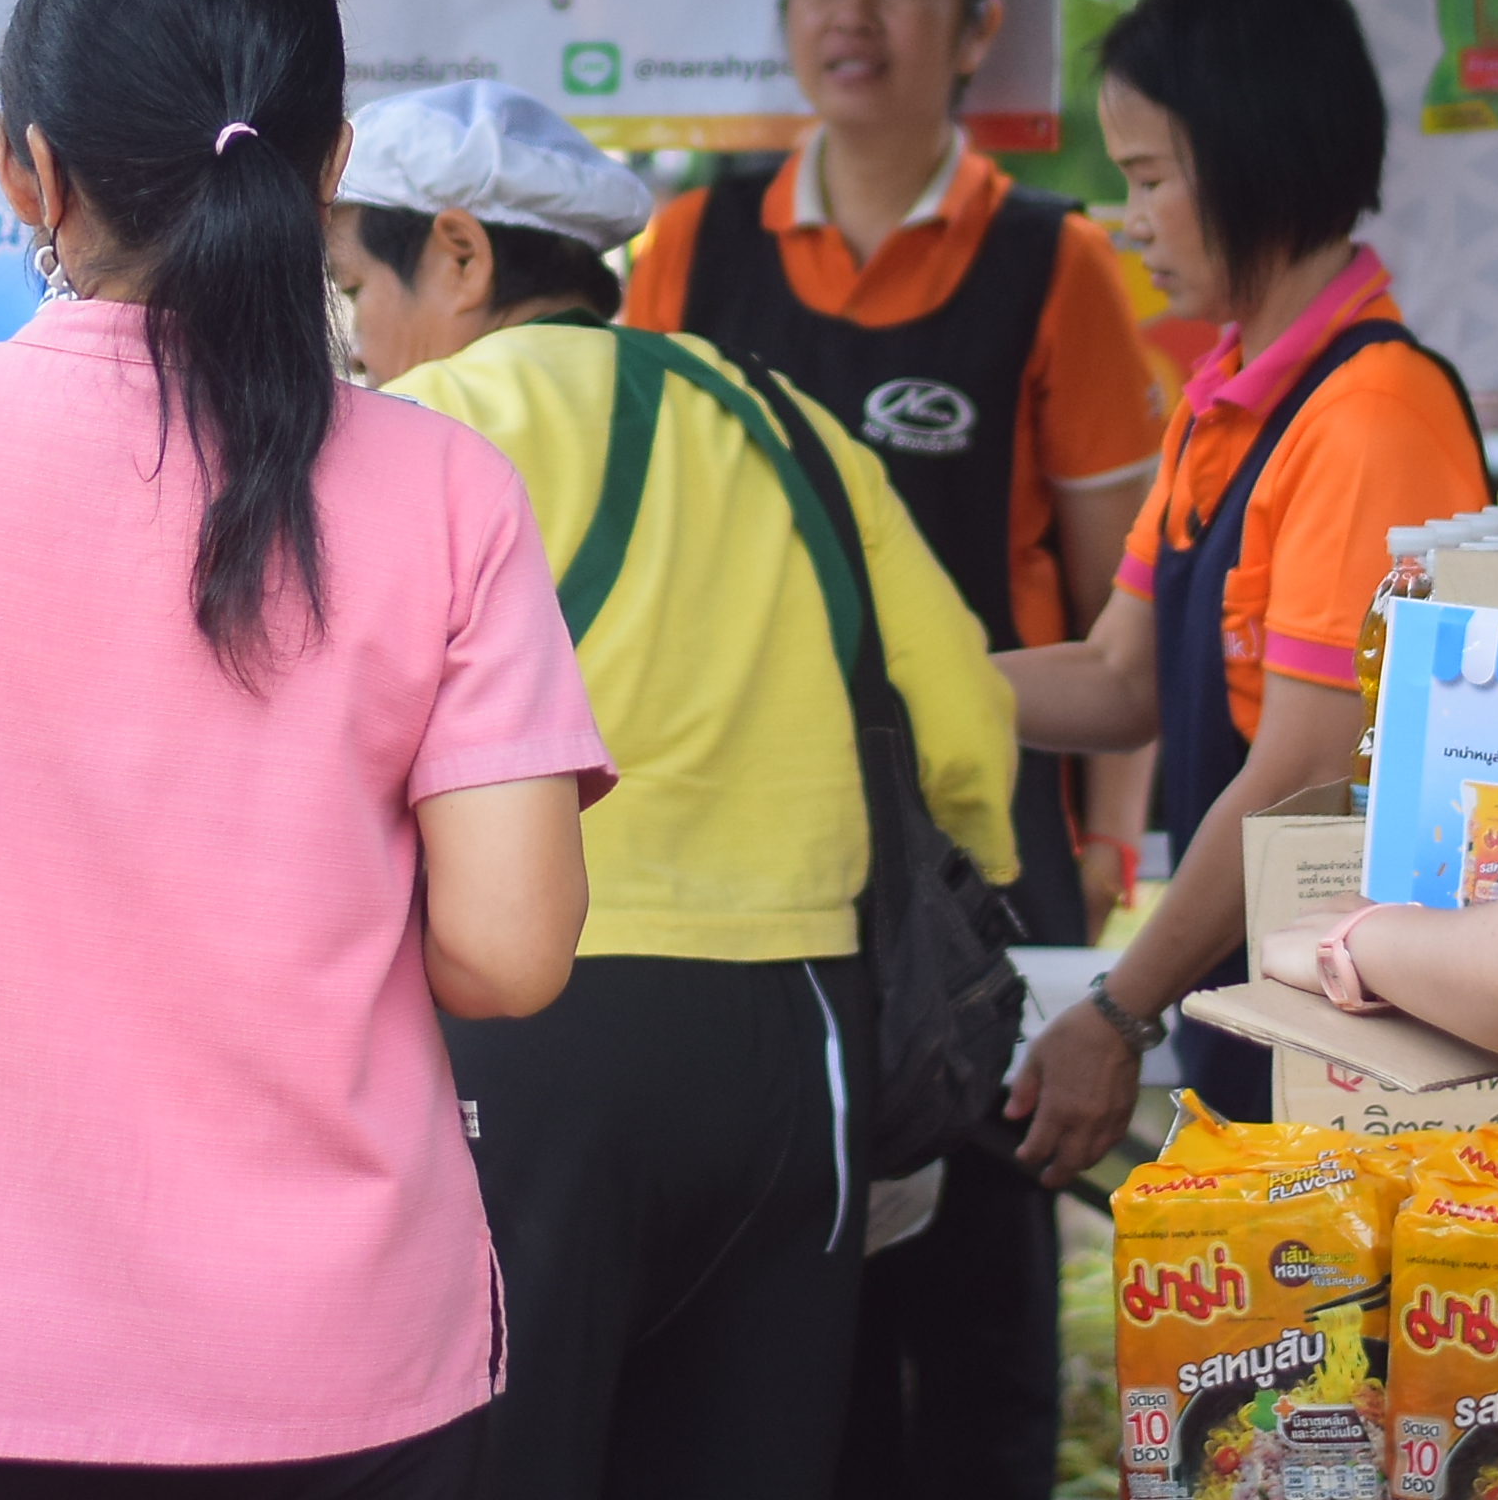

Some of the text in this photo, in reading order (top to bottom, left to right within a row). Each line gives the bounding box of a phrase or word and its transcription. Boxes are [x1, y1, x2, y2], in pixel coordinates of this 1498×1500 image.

[1135, 1175, 1220, 1195] MAMA
[1268, 1169, 1356, 1203] FLAVOUR
[1122, 1245, 1245, 1323] มาม่า
[1177, 1327, 1326, 1396] รสหมูสับ
[1126, 1410, 1170, 1446] 10
[1131, 1446, 1170, 1462] ซอง
[1402, 1440, 1439, 1477] 10
[1401, 1476, 1436, 1494] ซอง
